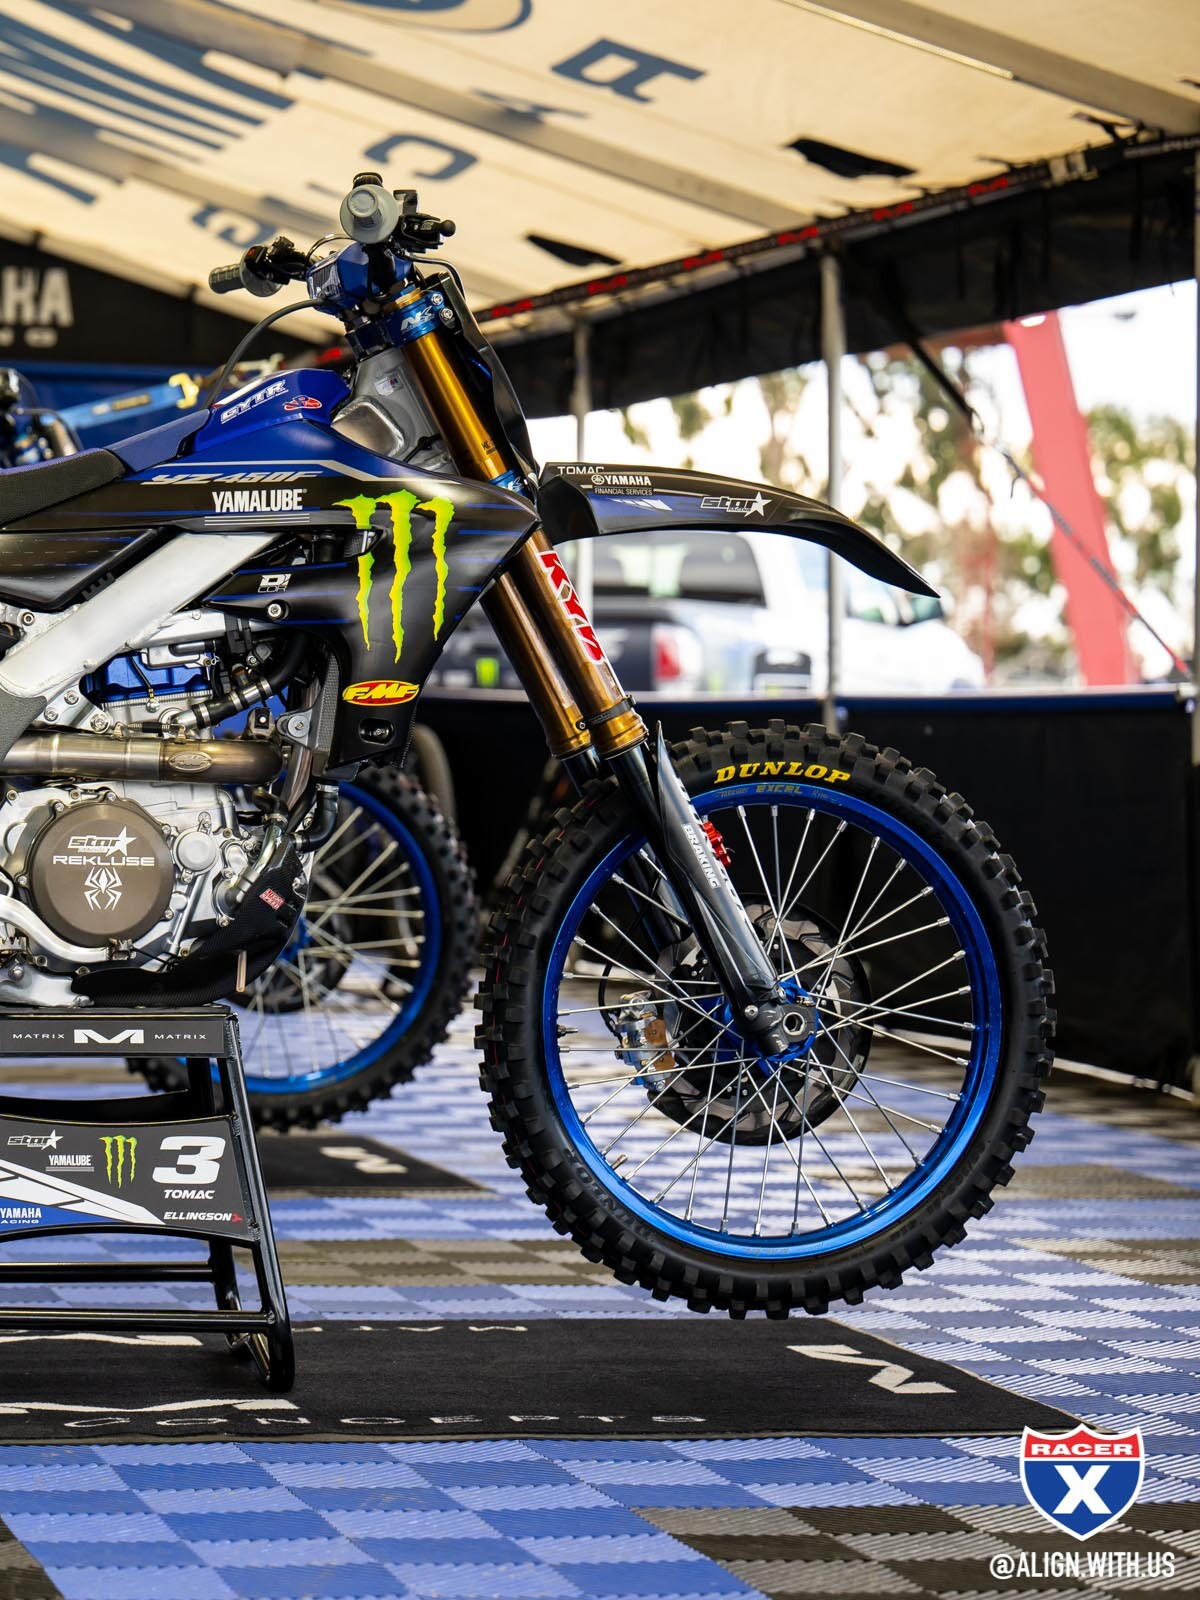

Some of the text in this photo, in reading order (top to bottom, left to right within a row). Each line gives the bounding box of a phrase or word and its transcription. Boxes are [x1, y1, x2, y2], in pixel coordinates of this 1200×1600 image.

[557, 466, 605, 476] TOMAC
[140, 470, 324, 486] YZ450F
[604, 475, 652, 487] YAMAHA
[594, 488, 653, 496] FINANCIAL SERVICES
[211, 488, 304, 514] YAMALUBE
[342, 682, 420, 701] FMF
[713, 760, 851, 785] DUNLOP
[755, 784, 803, 795] EXCEL
[52, 855, 155, 867] REKLUSE
[682, 824, 719, 889] BRAKING
[154, 1033, 207, 1041] MATRIX
[48, 1154, 93, 1166] YAMALUBE
[152, 1135, 226, 1184] 3
[163, 1189, 216, 1200] TOMAC
[0, 1207, 42, 1219] YAMAHA
[163, 1211, 232, 1222] ELLINGSON
[64, 1414, 705, 1428] CONCEPTS
